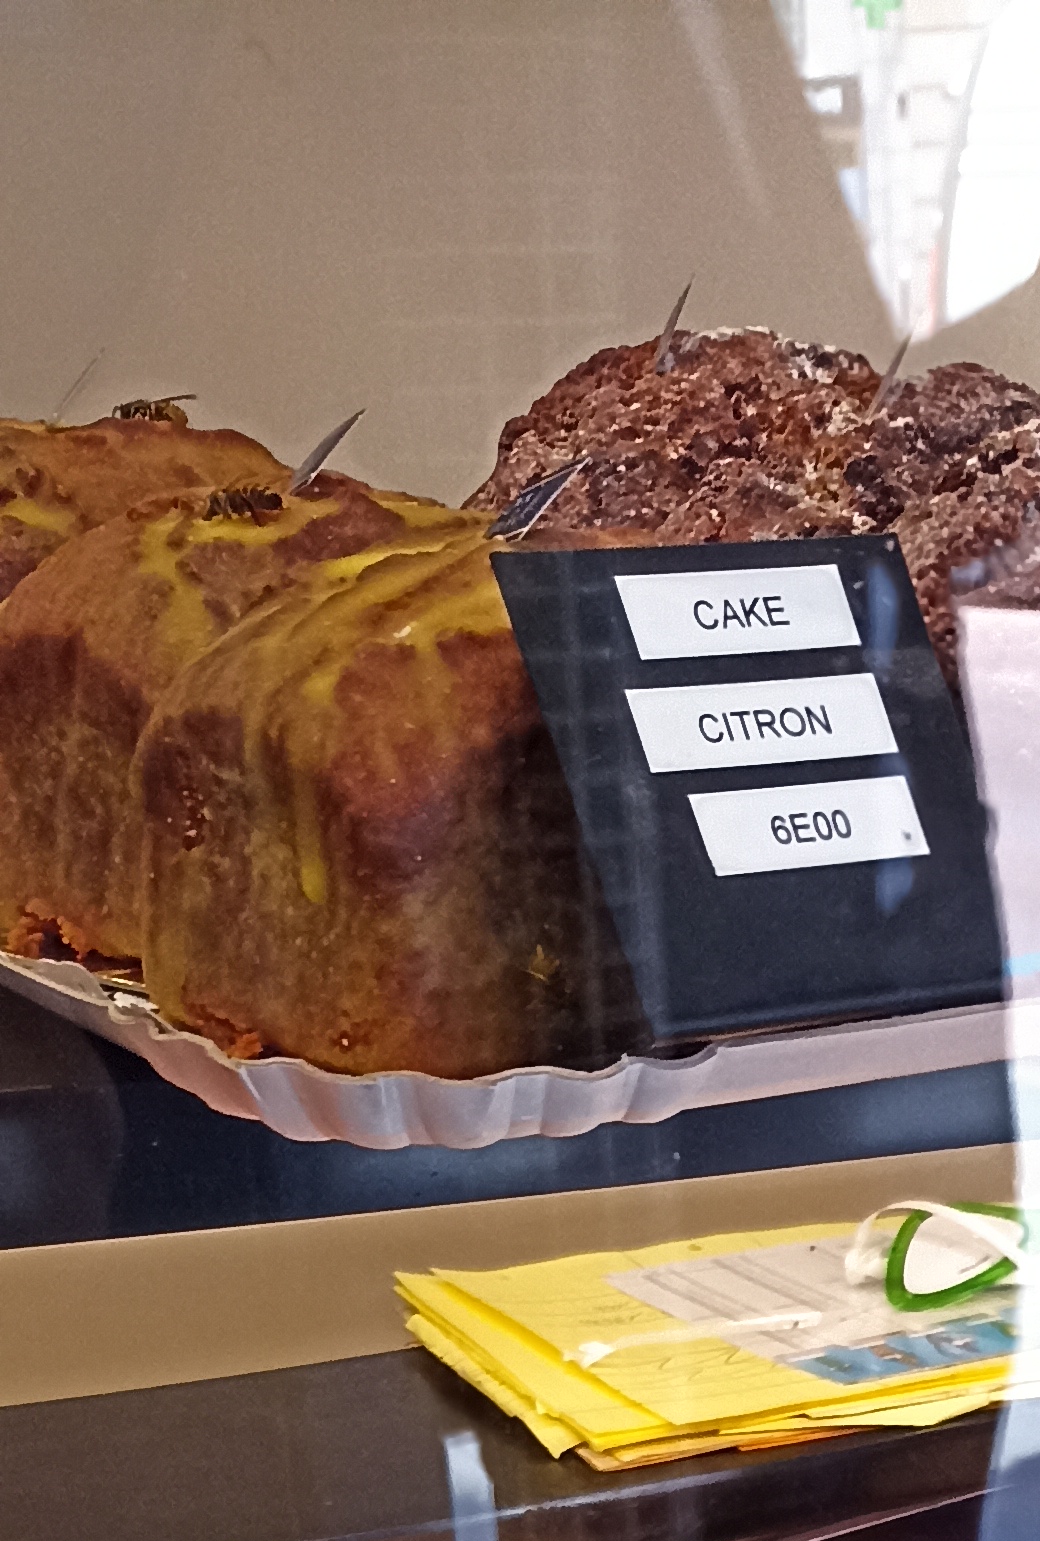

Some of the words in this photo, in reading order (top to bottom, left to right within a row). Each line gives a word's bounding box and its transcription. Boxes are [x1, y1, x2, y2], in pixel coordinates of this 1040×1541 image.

[694, 596, 790, 630] CAKE
[699, 705, 832, 743] CITRON
[771, 810, 851, 845] 6E00
